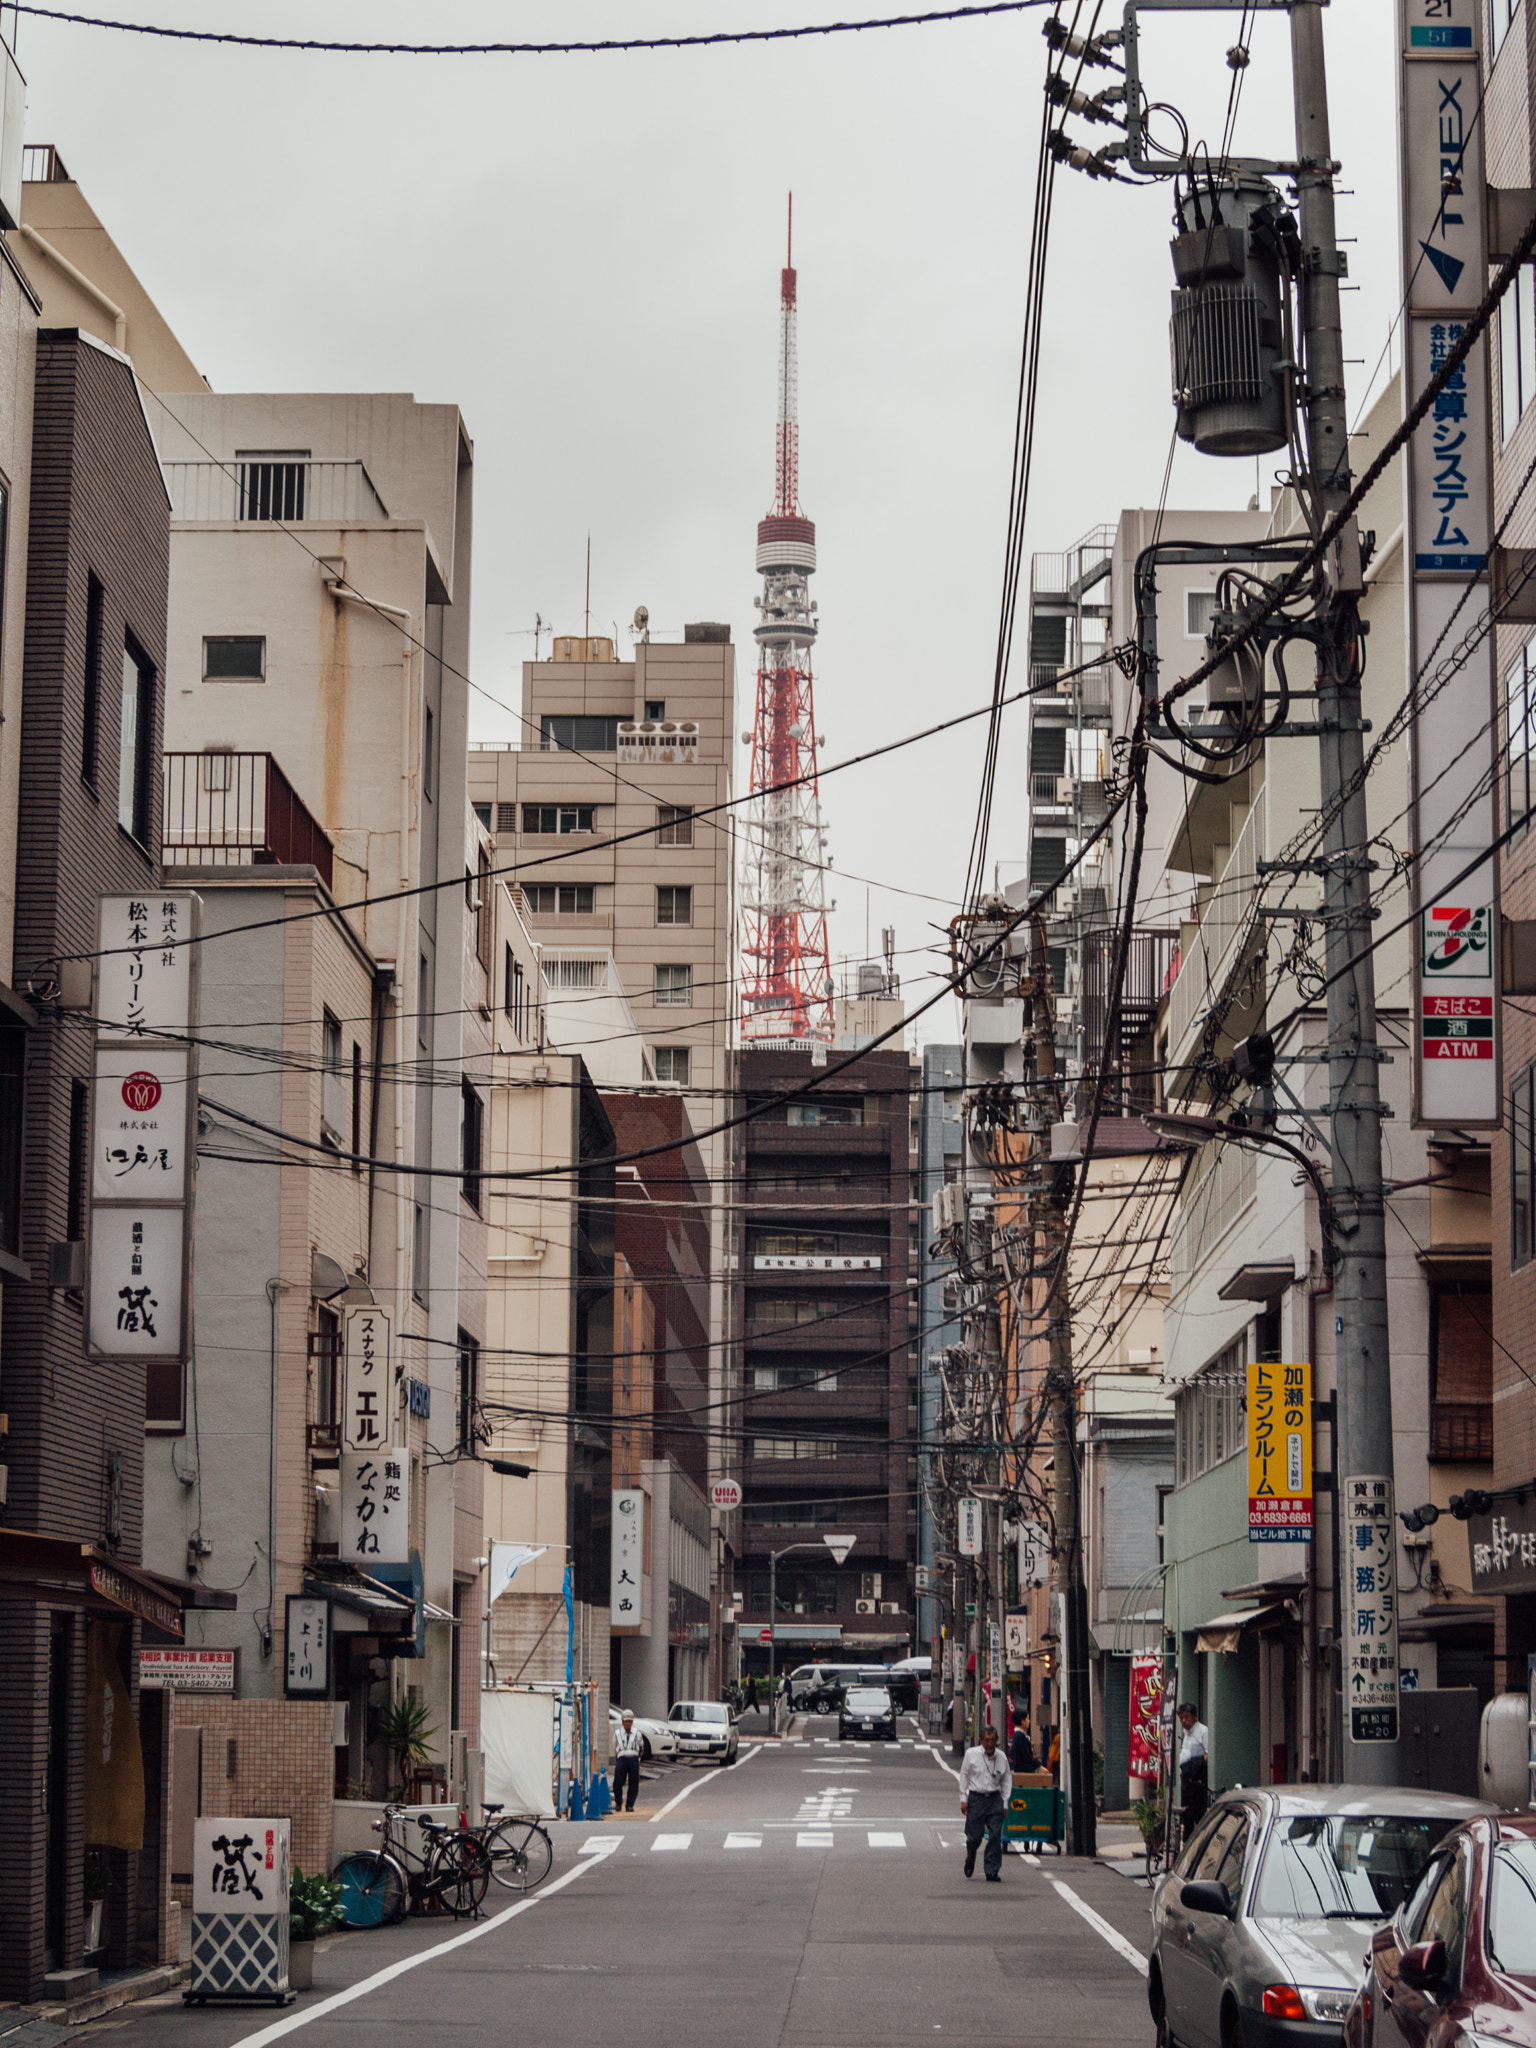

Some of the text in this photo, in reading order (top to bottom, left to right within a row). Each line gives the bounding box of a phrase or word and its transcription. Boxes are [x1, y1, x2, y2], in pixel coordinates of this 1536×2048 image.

[1428, 30, 1452, 42] 5F
[161, 901, 177, 967] 株式会社
[125, 901, 148, 1038] 松本マリーンズ
[1434, 998, 1482, 1015] たばこ
[1447, 1019, 1468, 1036] 酒
[1438, 1043, 1478, 1057] ATM
[120, 1121, 159, 1130] 株式会社
[106, 1144, 173, 1177] 江戸屋
[356, 1318, 379, 1442] スナック エル
[1284, 1366, 1304, 1427] 加瀬の
[1255, 1366, 1275, 1496] トランクルーム
[1290, 1437, 1300, 1488] ネットで契約
[356, 1461, 381, 1555] なかね
[1256, 1500, 1304, 1511] 加瀬倉庫
[1355, 1523, 1376, 1637] 事務所
[1375, 1524, 1393, 1637] マンション
[1360, 1642, 1388, 1655] 地元
